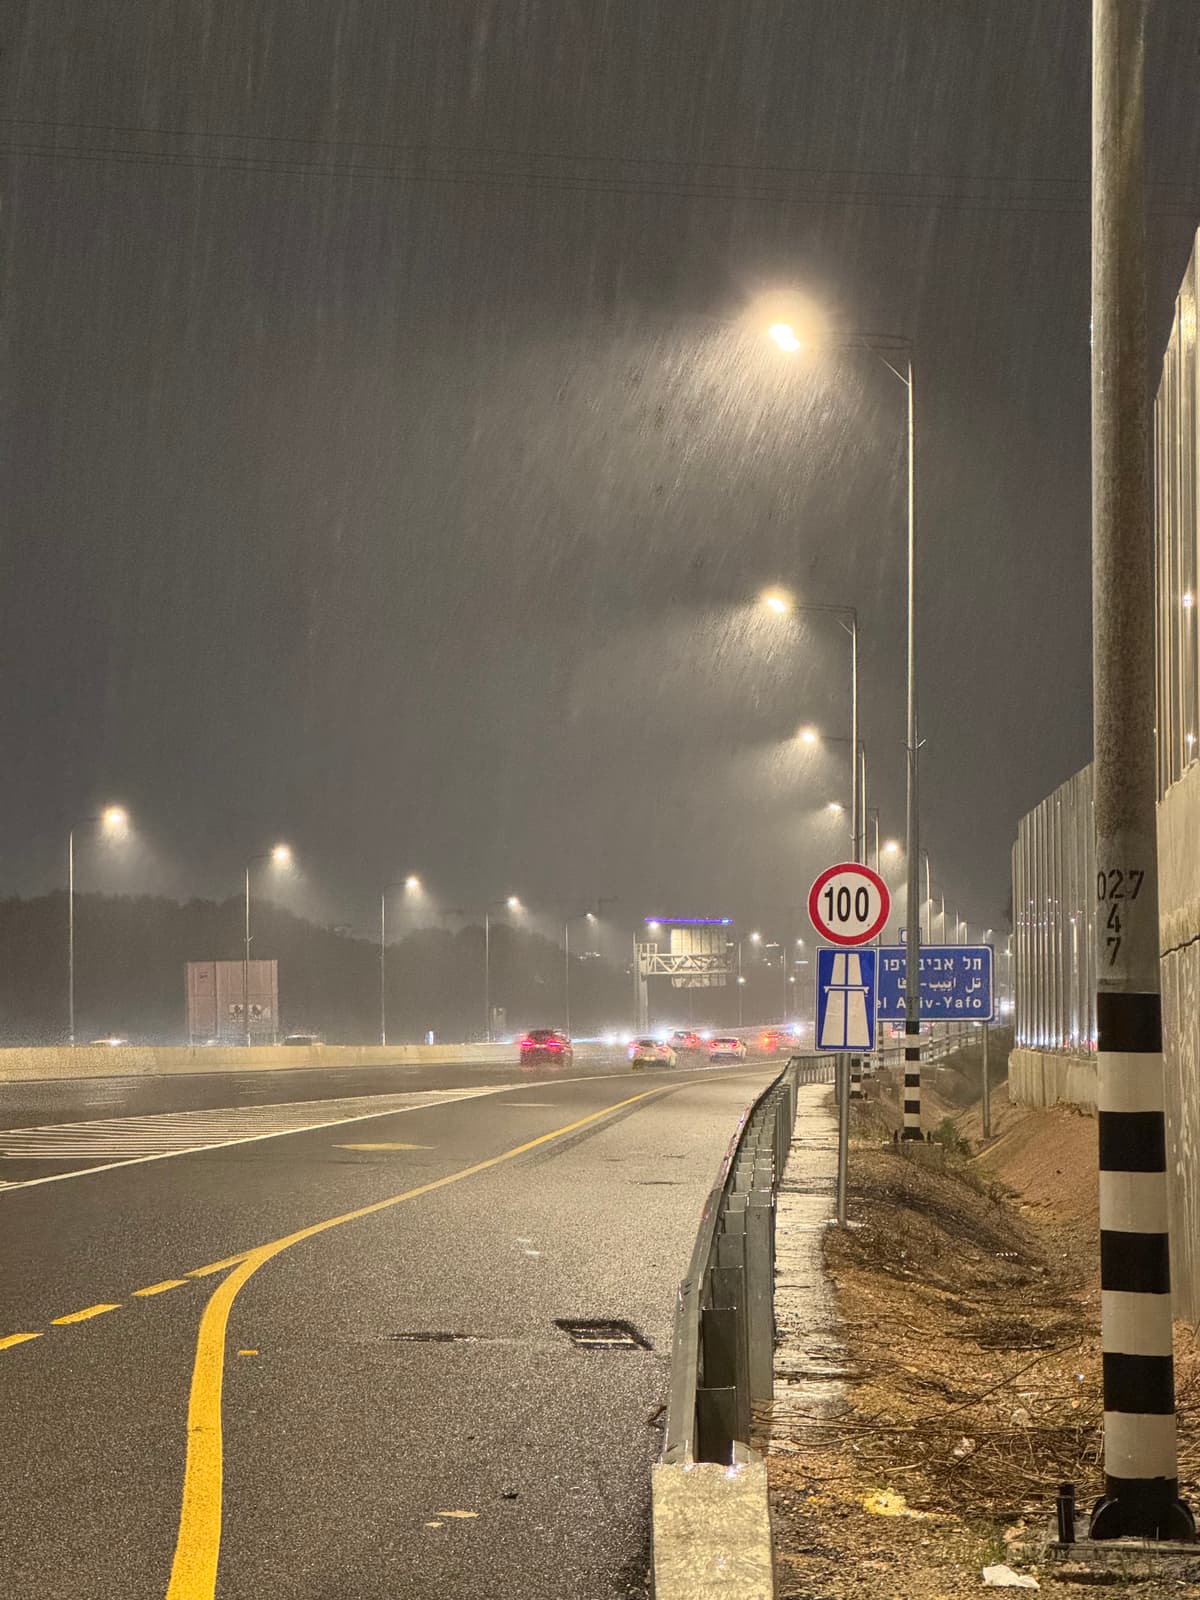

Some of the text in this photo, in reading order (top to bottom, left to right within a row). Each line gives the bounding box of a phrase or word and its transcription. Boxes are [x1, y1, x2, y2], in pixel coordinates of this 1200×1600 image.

[1097, 869, 1144, 900] 027
[824, 887, 869, 922] 100
[1107, 903, 1121, 933] 4
[963, 956, 982, 971] תל
[1107, 936, 1121, 966] 7
[965, 977, 981, 993] تل
[896, 997, 982, 1009] Aiv-Yafo
